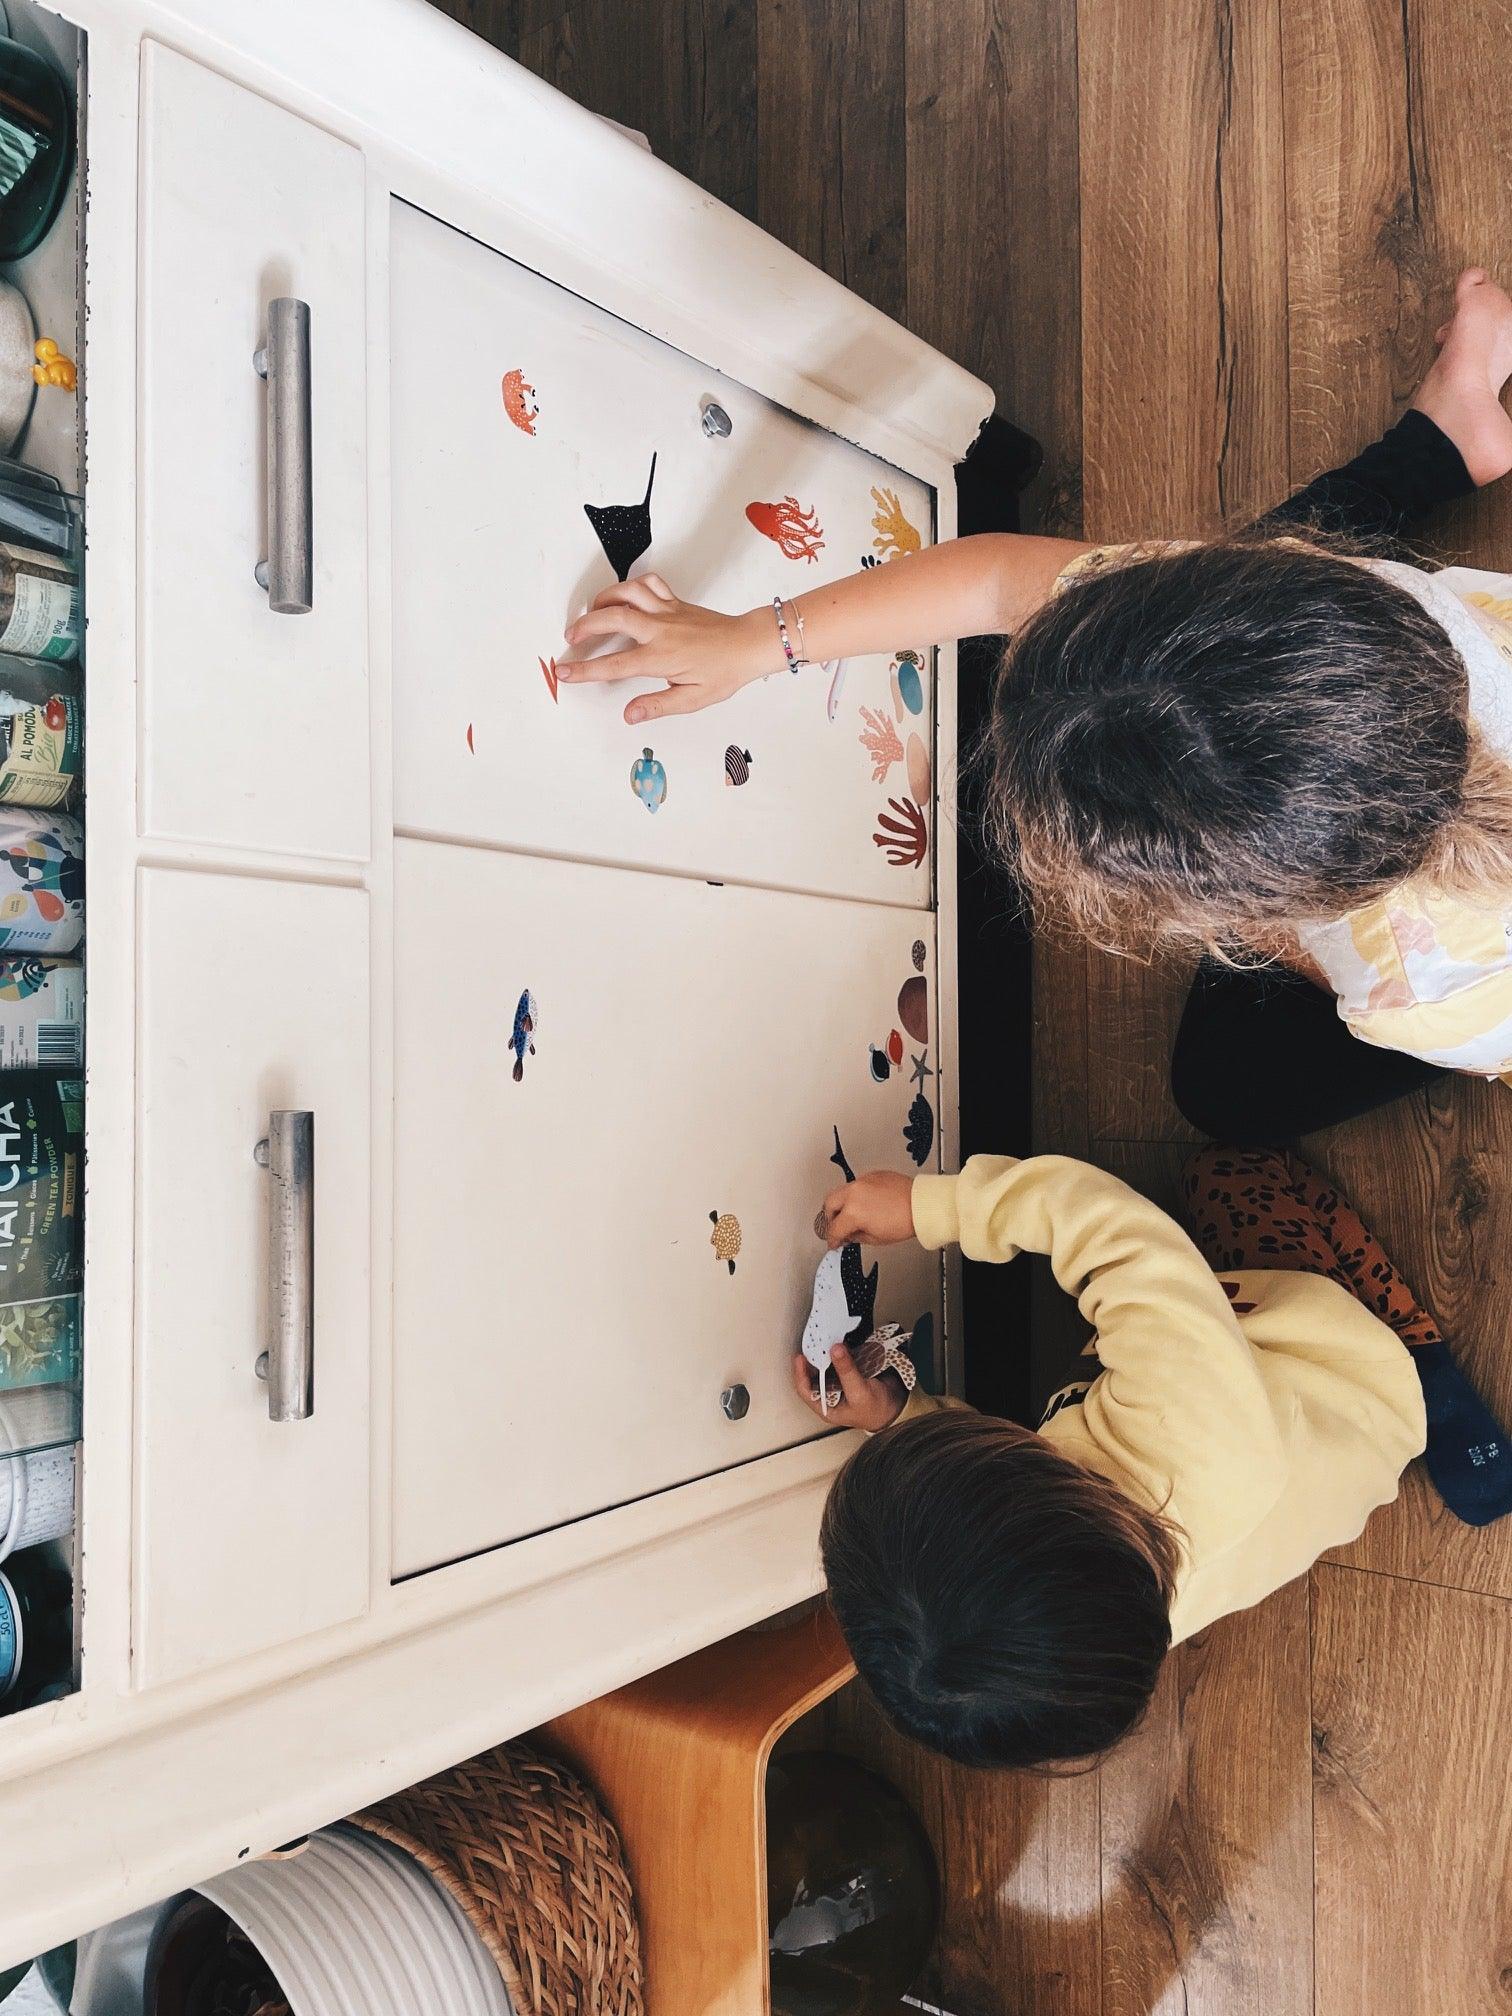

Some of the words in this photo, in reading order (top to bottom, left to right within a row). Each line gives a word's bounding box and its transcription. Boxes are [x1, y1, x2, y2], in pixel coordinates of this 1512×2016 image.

[52, 619, 67, 636] 90g
[20, 749, 33, 760] AL
[34, 734, 56, 770] Bio
[30, 1132, 39, 1164] Pâtisseries
[43, 1136, 59, 1180] POWDER
[0, 1101, 21, 1272] ACHA
[29, 1179, 38, 1200] Glaces
[49, 1180, 59, 1200] TEA
[65, 1164, 75, 1206] TONIQUE
[26, 1211, 37, 1236] Boissons
[39, 1202, 57, 1236] GREEN
[0, 1621, 11, 1636] 50
